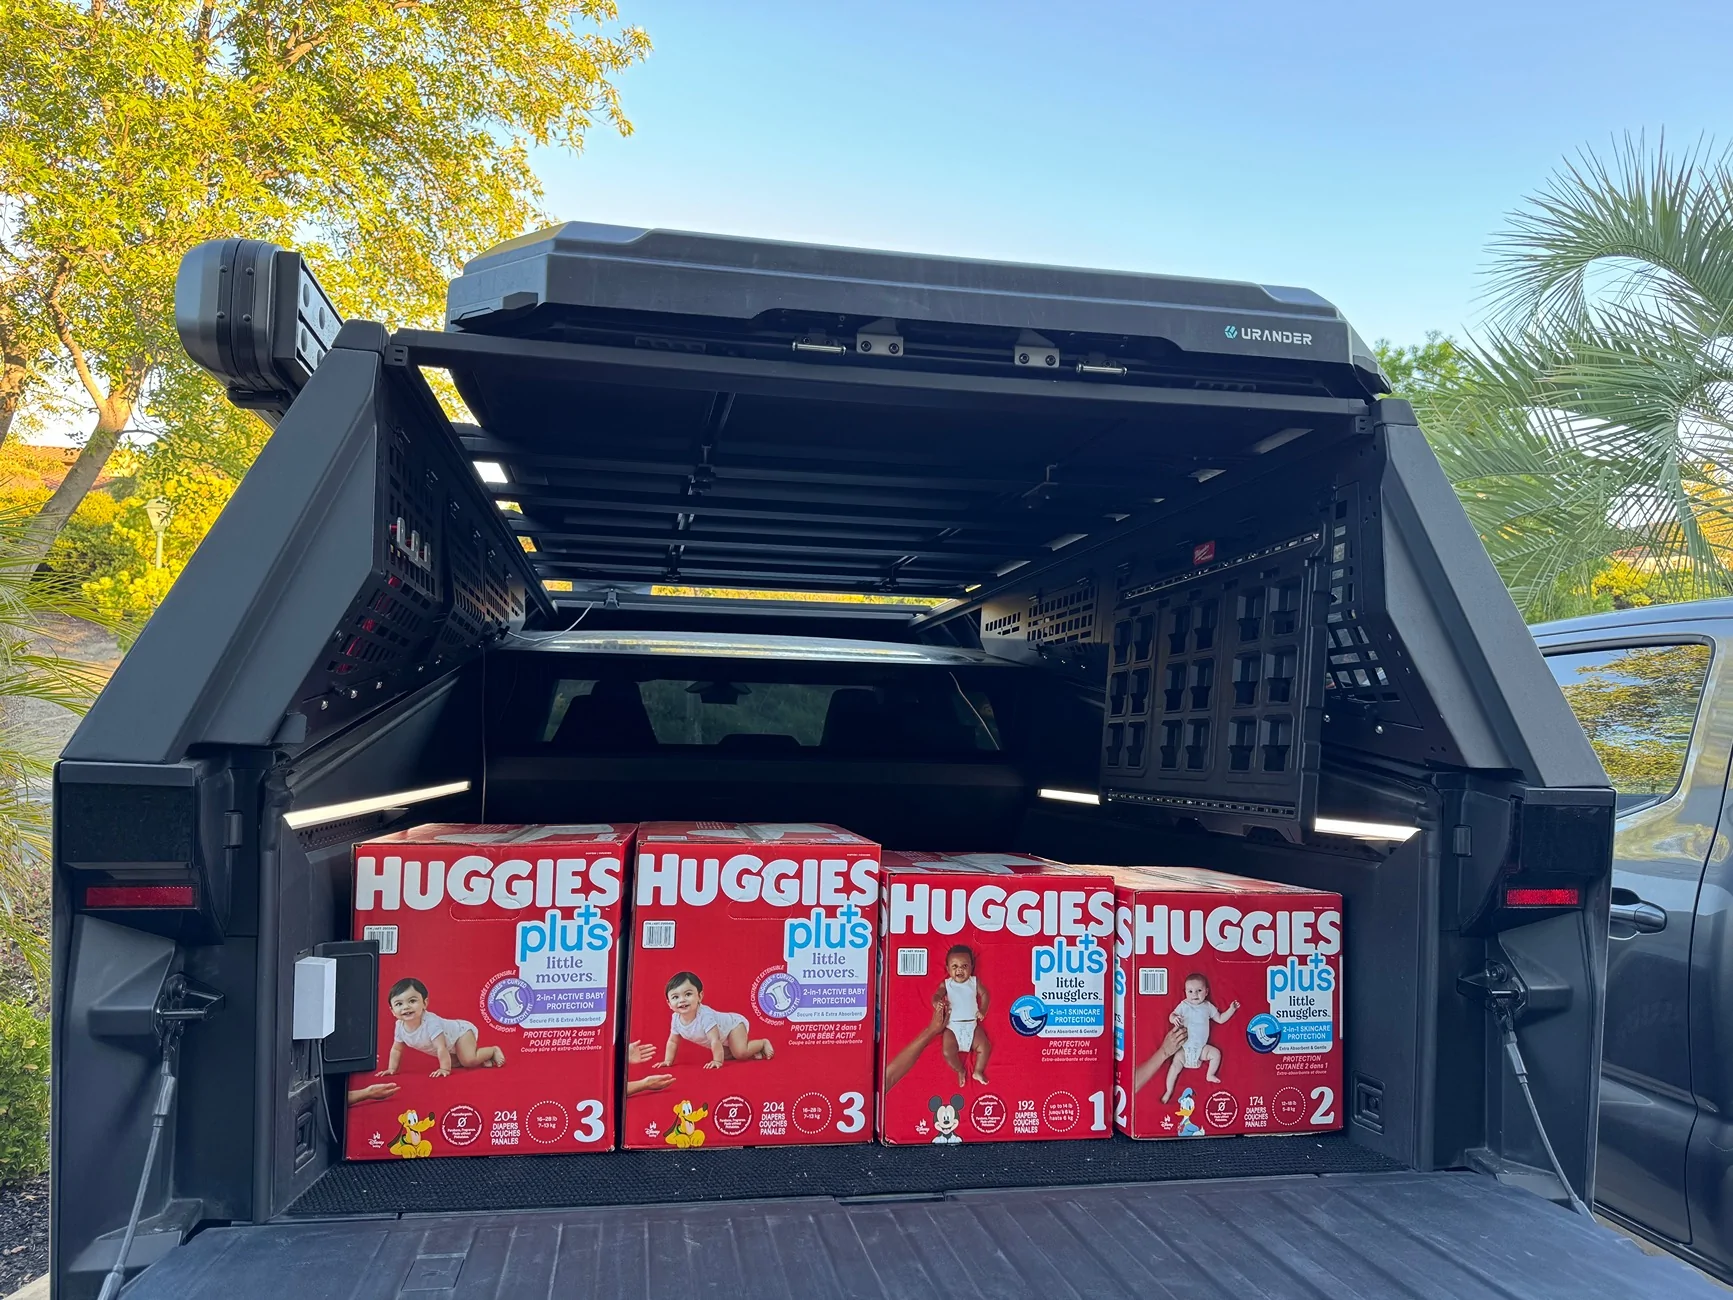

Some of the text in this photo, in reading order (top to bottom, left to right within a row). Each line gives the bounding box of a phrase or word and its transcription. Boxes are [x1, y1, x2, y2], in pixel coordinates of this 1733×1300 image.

[1241, 327, 1313, 346] URANDER
[355, 855, 621, 911] HUGGIES
[636, 853, 880, 907] HUGGIES
[890, 883, 1115, 937] HUGGIES
[1135, 904, 1341, 957] HUGGIES
[546, 956, 583, 969] little
[812, 953, 846, 965] little
[1056, 977, 1085, 988] little
[558, 993, 584, 1001] ACTIVE
[1289, 995, 1315, 1006] little
[546, 1002, 594, 1010] PROTECTION
[1055, 1016, 1095, 1024] PROTECTION
[523, 1030, 571, 1038] PROTECTION
[578, 1029, 595, 1037] dans
[796, 1032, 816, 1040] POUR
[817, 1031, 835, 1039] BÉBÉ
[530, 1039, 552, 1047] POUR
[552, 1037, 571, 1046] BÉBÉ
[1275, 1062, 1304, 1070] CUTANÉE
[1017, 1100, 1035, 1110] 192
[1249, 1096, 1263, 1106] 174
[1310, 1086, 1335, 1125] 2
[763, 1102, 784, 1112] 204
[1088, 1090, 1107, 1131] 1
[1114, 1085, 1127, 1128] 2
[494, 1111, 518, 1121] 204
[836, 1091, 866, 1133] 3
[492, 1122, 519, 1130] DIAPERS
[574, 1099, 605, 1143] 3
[759, 1120, 787, 1128] COUCHES
[760, 1127, 785, 1135] PAÑALES
[1014, 1125, 1038, 1133] PAÑALES
[491, 1136, 519, 1145] PAÑALES
